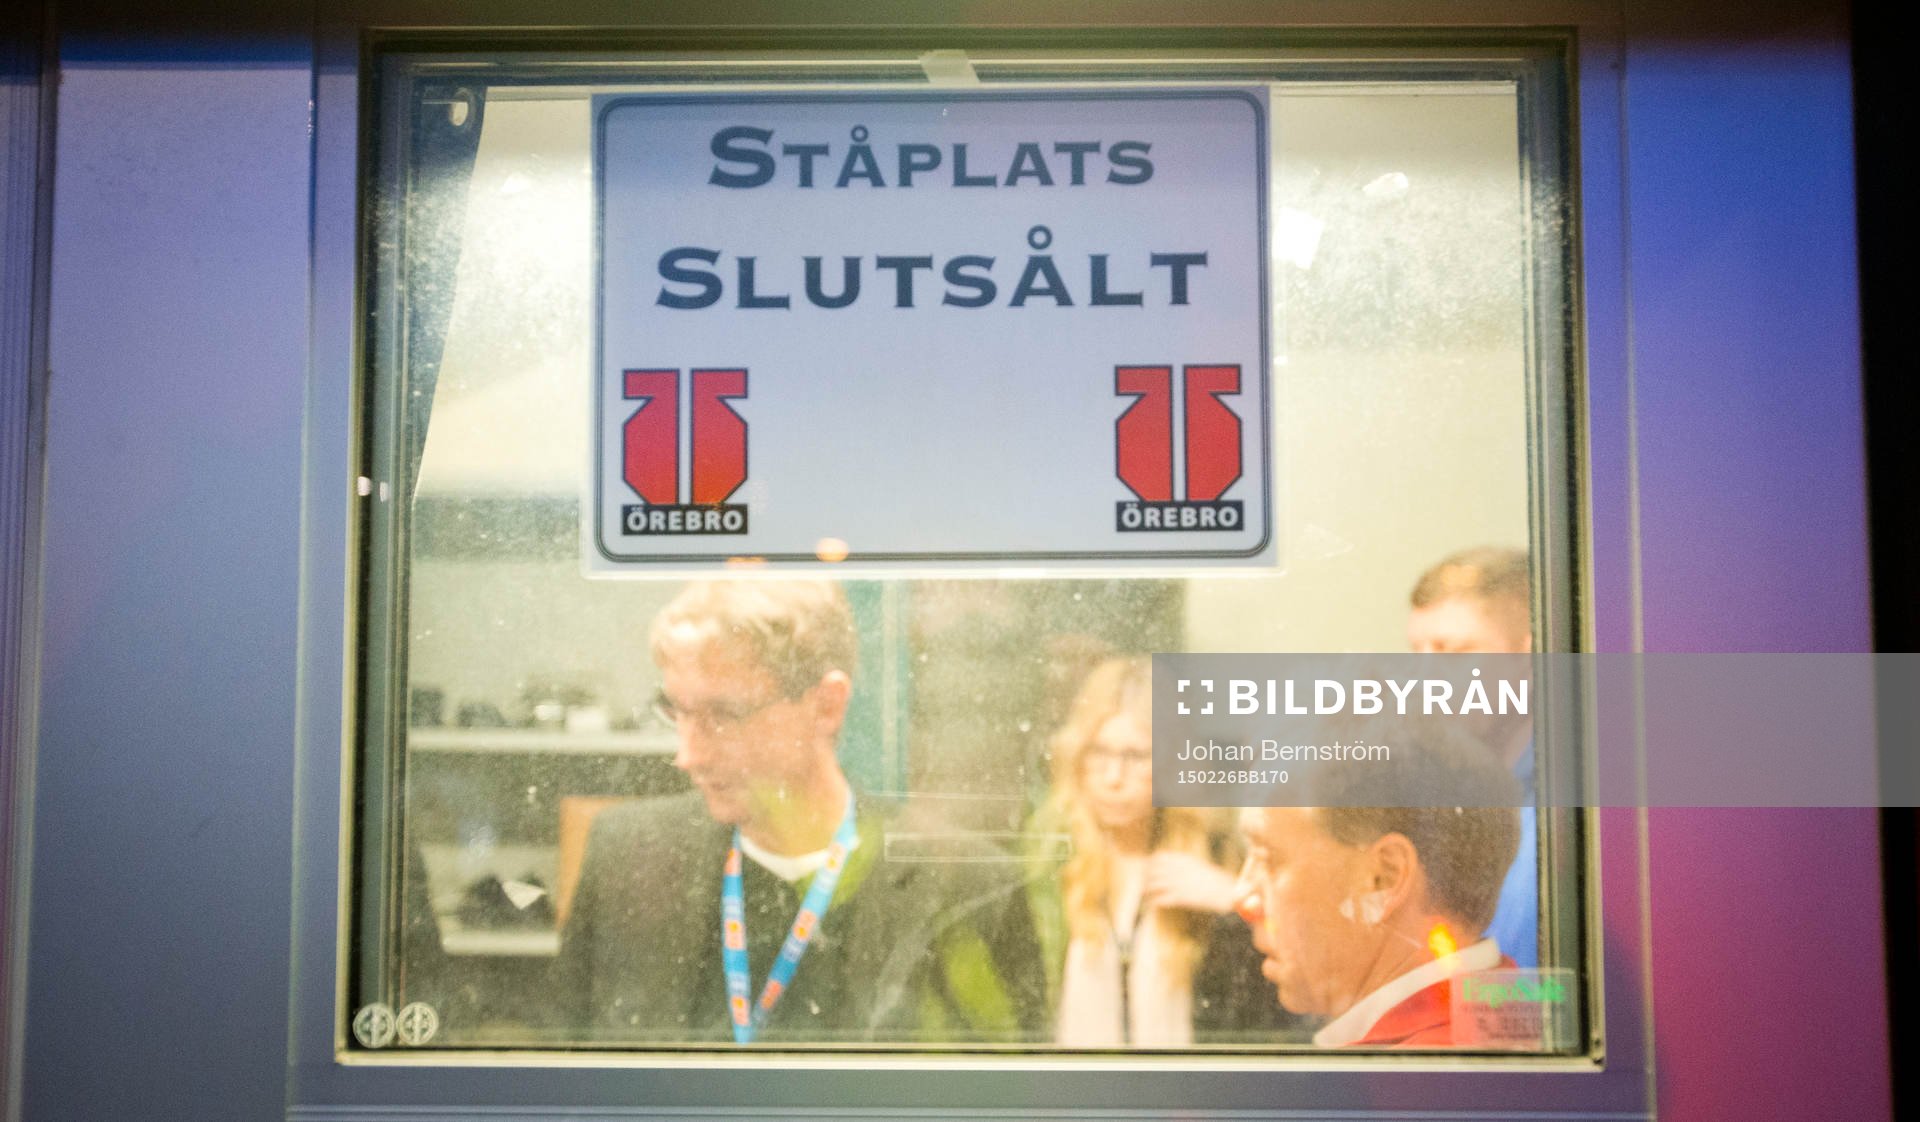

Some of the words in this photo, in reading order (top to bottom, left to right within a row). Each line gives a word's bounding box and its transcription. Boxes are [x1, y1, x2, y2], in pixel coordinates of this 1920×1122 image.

[707, 125, 1155, 188] STÅPLATS
[655, 226, 1208, 310] SLUTSÅLT
[627, 506, 744, 532] ÖREBRO
[1122, 502, 1239, 529] ÖREBRO
